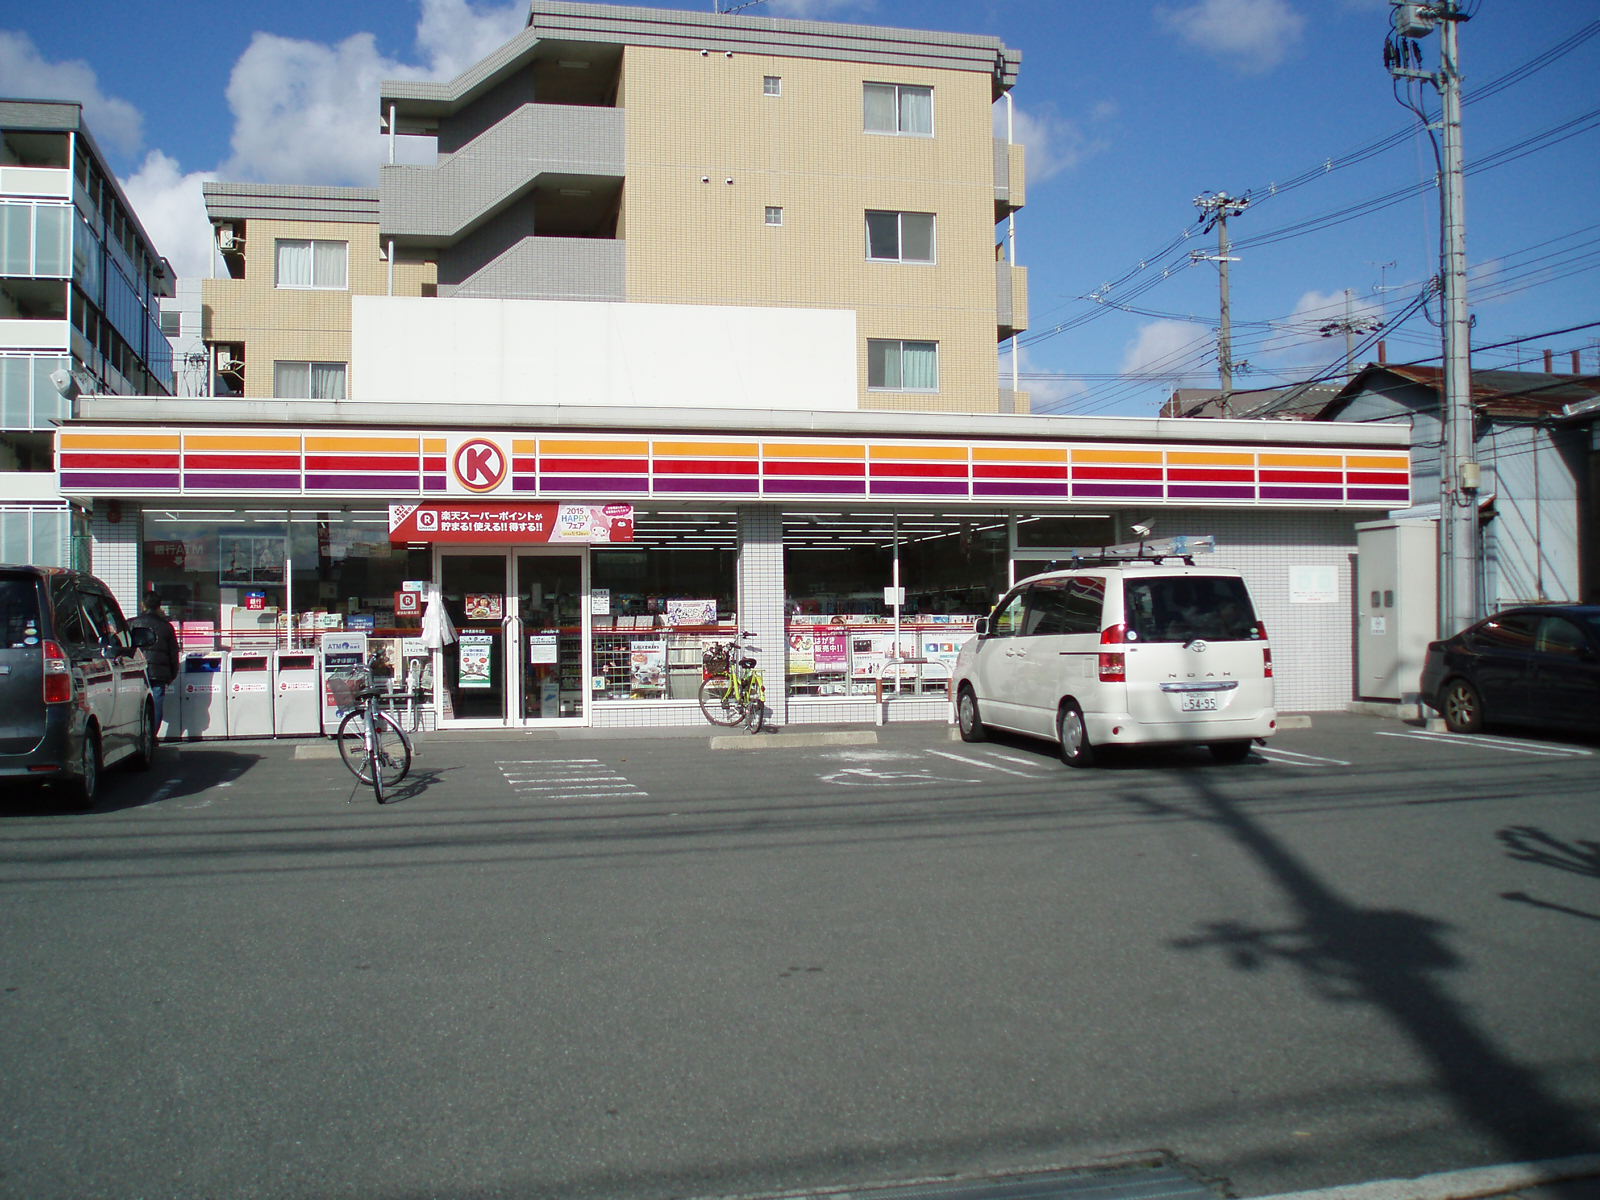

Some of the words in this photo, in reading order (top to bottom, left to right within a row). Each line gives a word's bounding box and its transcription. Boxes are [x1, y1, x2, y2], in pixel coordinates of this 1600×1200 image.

[467, 448, 500, 484] K
[566, 507, 584, 515] 2015
[441, 511, 543, 521] 楽天スーパーポイントが
[561, 514, 589, 522] HAPPY
[566, 522, 585, 530] フェア
[1188, 698, 1217, 709] 54-95
